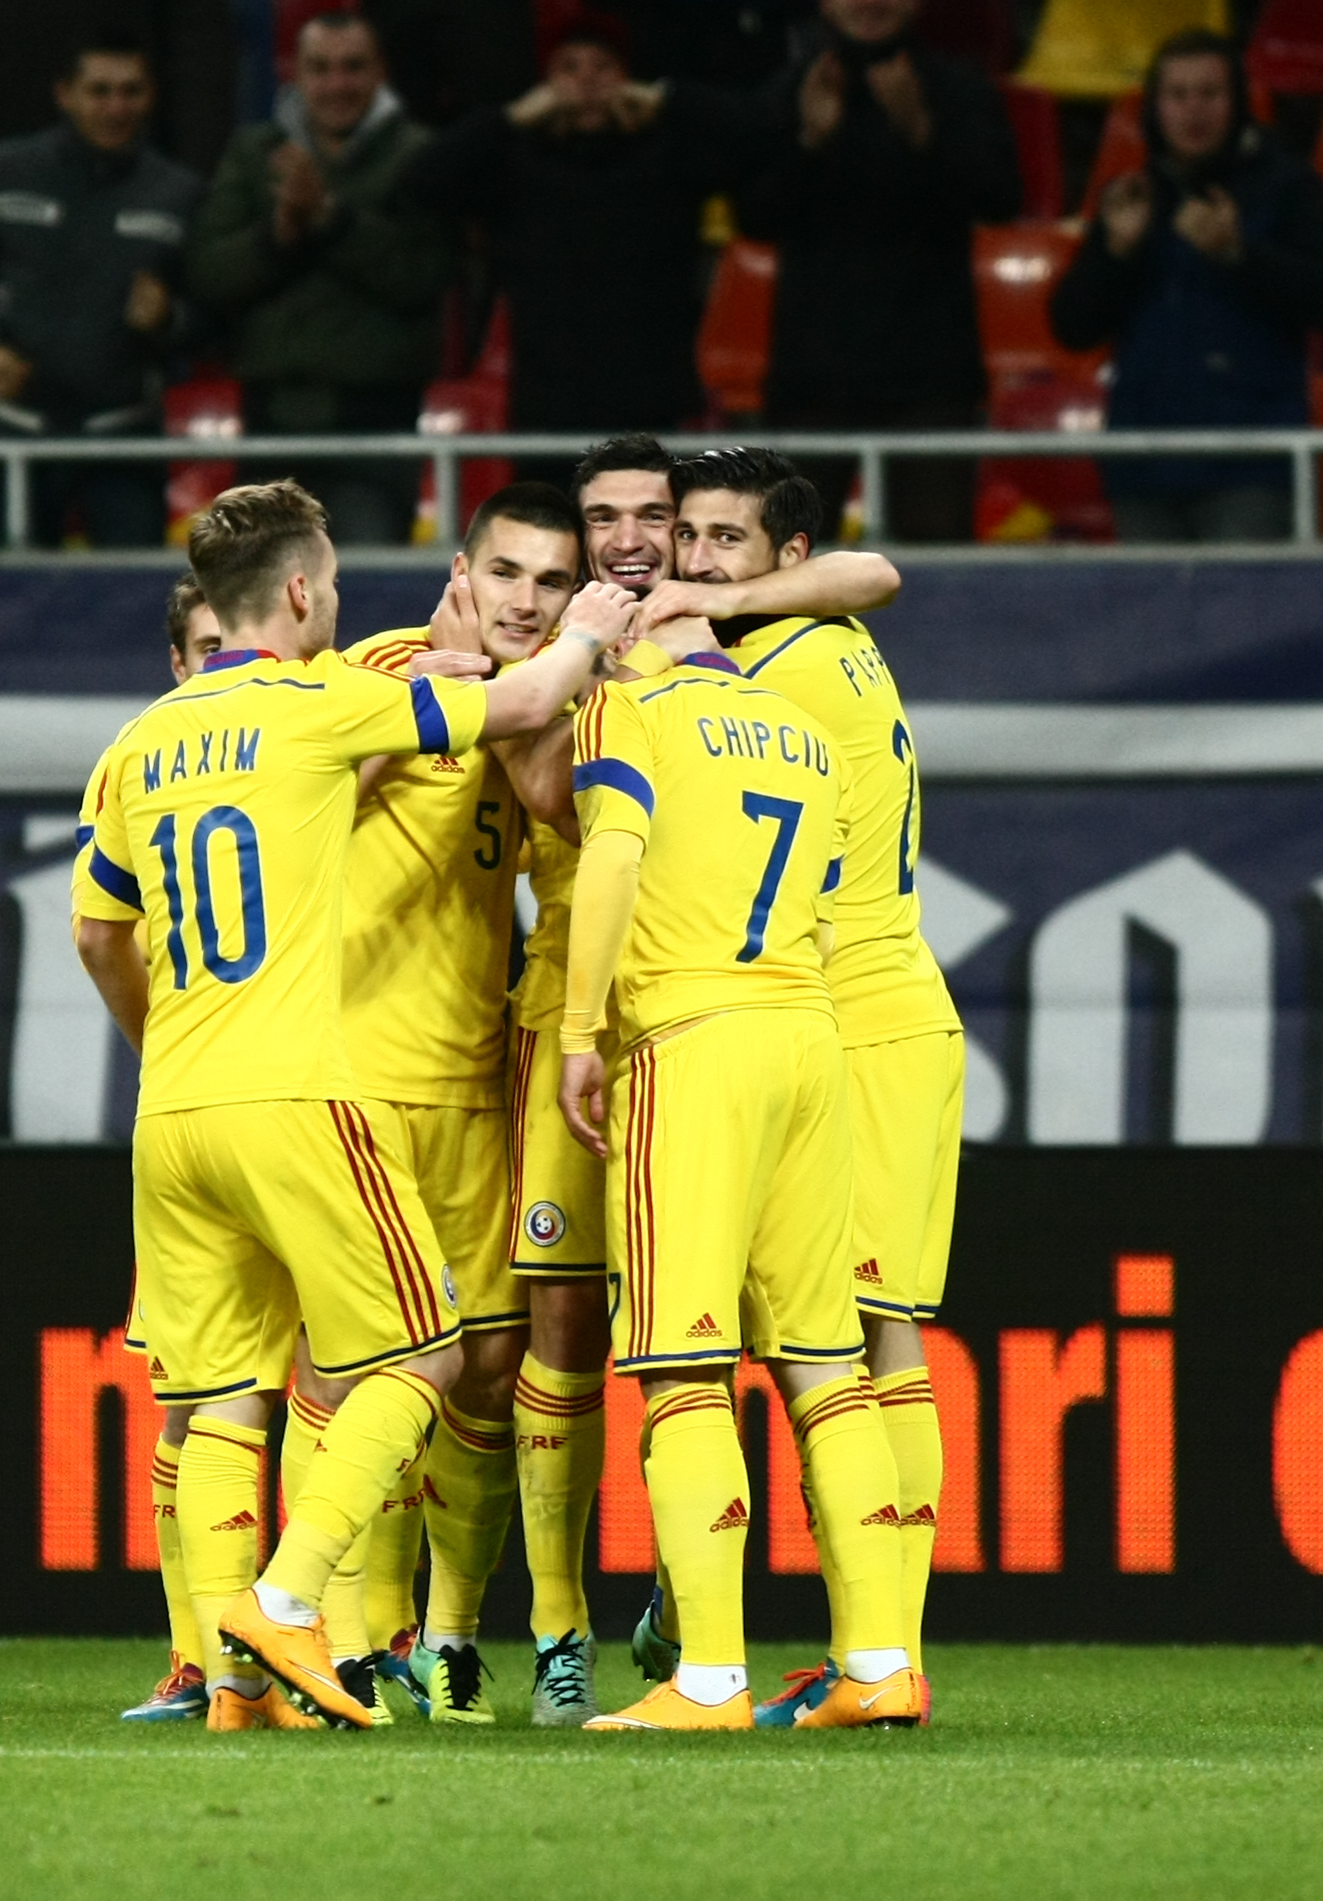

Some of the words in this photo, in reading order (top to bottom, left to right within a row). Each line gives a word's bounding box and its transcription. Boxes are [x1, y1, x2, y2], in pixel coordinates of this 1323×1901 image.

[144, 727, 261, 794] MAXIM
[697, 716, 829, 777] CHIPCIU
[473, 801, 501, 870] 5
[148, 805, 267, 990] 10
[735, 790, 804, 964] 7
[516, 1435, 568, 1450] FRF
